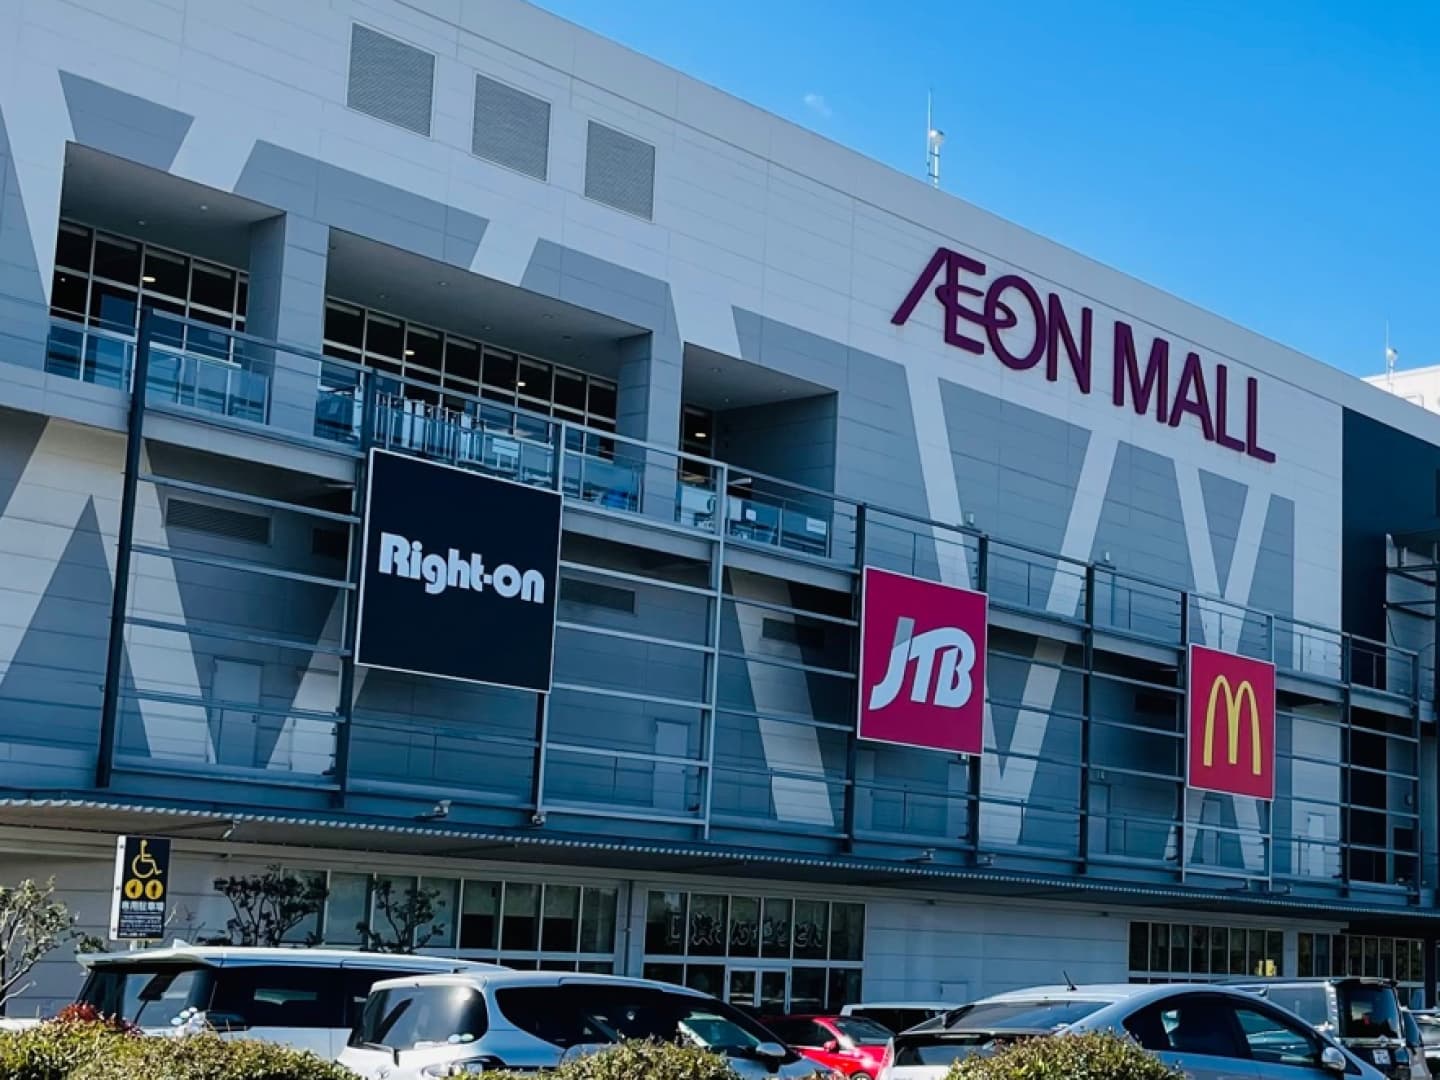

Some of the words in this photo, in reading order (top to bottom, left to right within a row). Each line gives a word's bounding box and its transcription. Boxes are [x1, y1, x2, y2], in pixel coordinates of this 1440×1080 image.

[1112, 320, 1276, 464] MALL
[378, 531, 545, 604] Right-on
[869, 616, 977, 711] JTB
